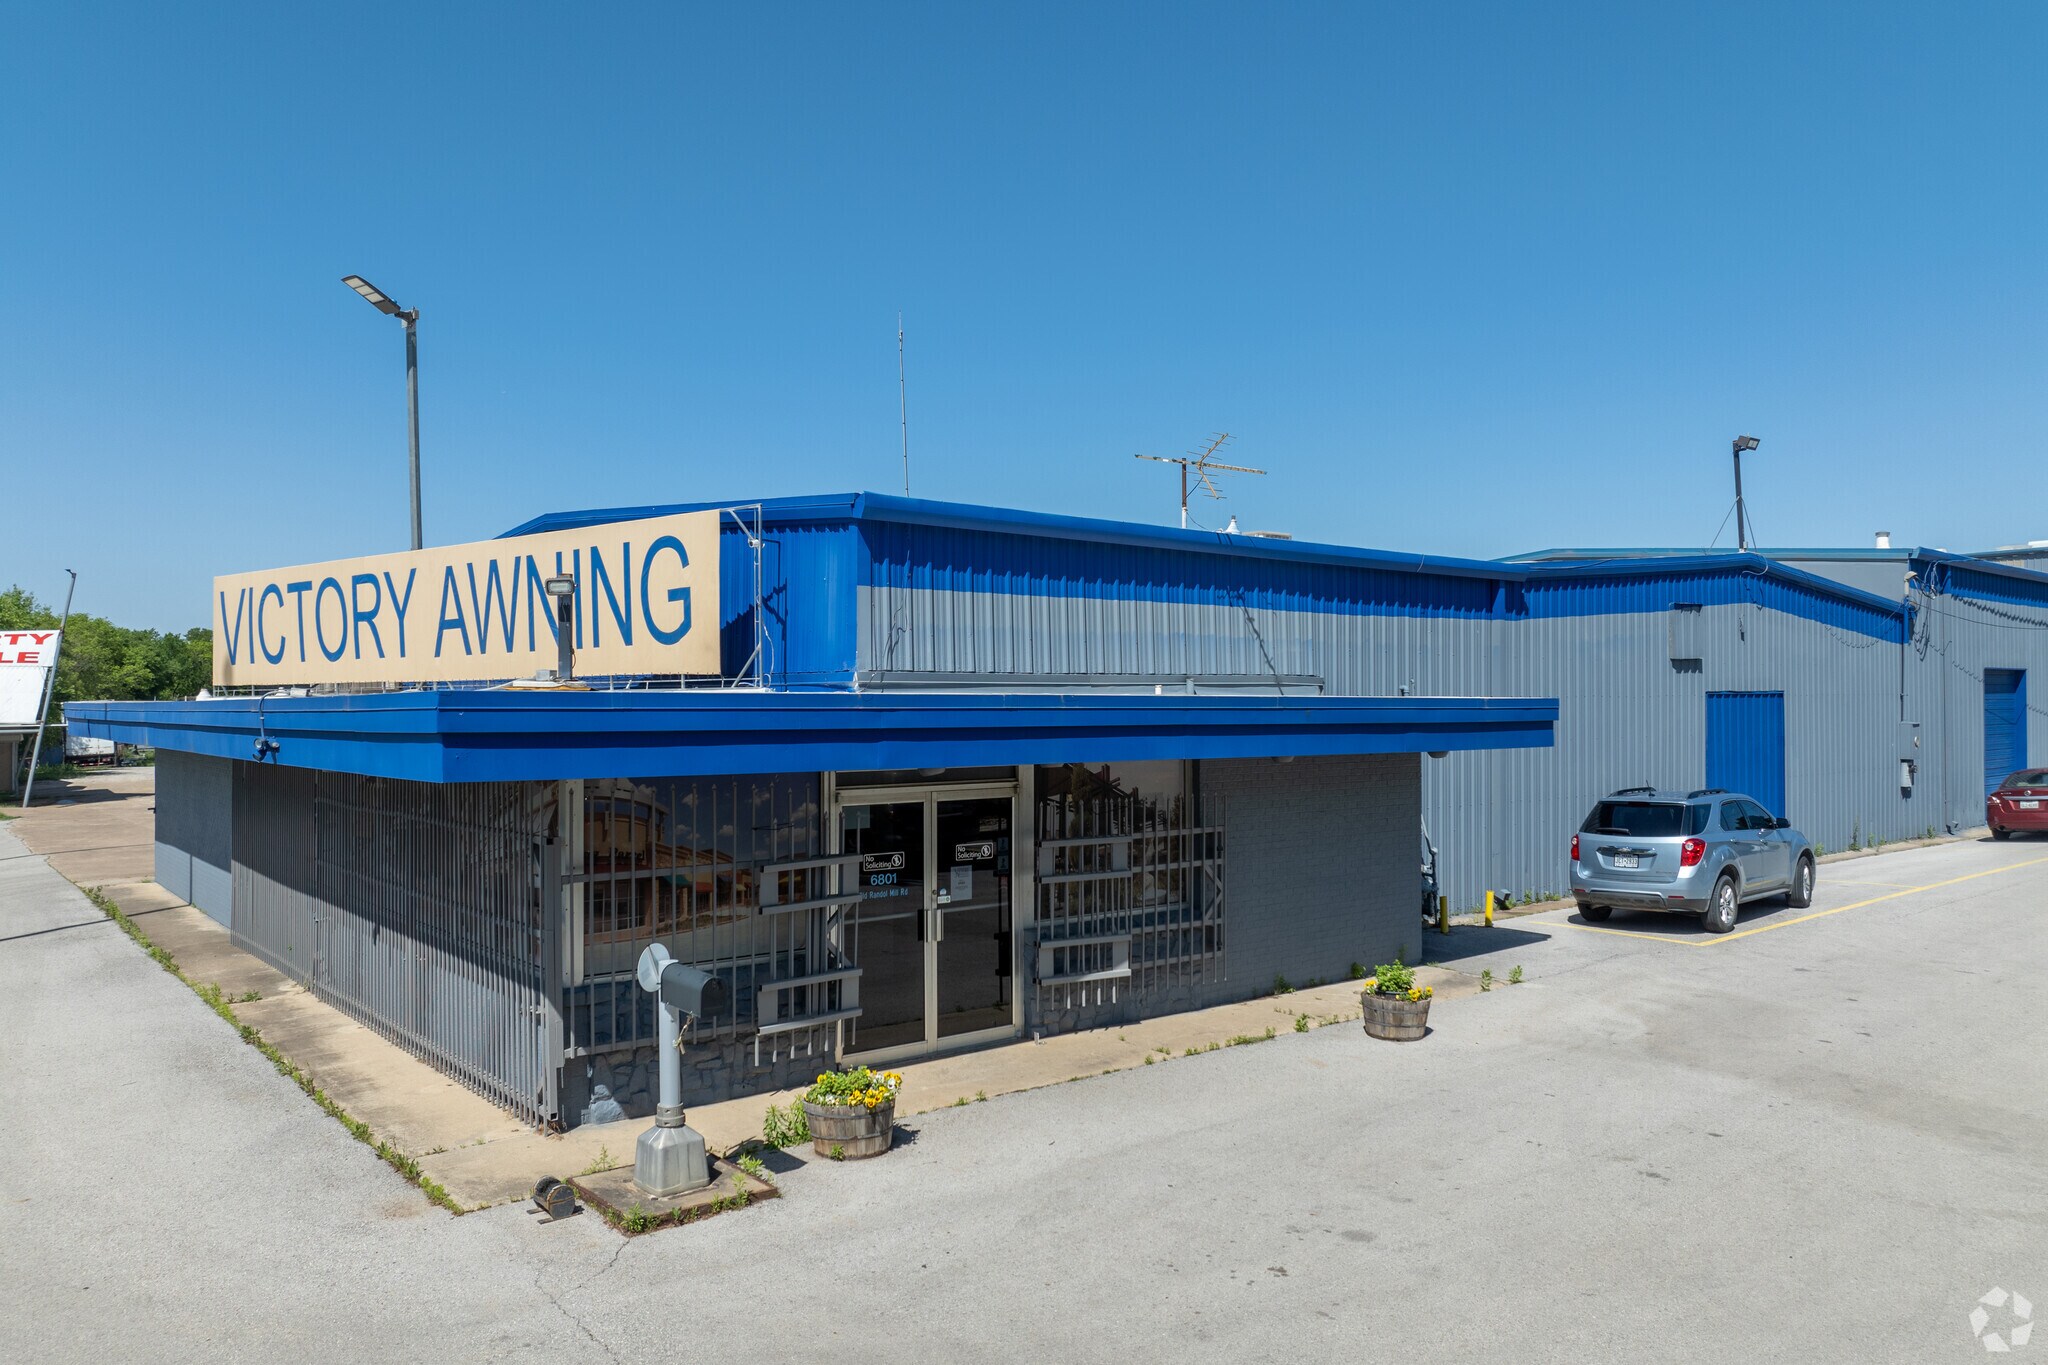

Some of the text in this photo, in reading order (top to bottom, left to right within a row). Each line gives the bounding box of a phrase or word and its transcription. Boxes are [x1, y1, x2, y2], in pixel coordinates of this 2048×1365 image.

[219, 535, 693, 666] VICTORY AWNING
[0, 633, 54, 645] TY
[957, 851, 981, 859] Soliciting
[865, 861, 892, 870] Soliciting
[870, 873, 897, 886] 6801
